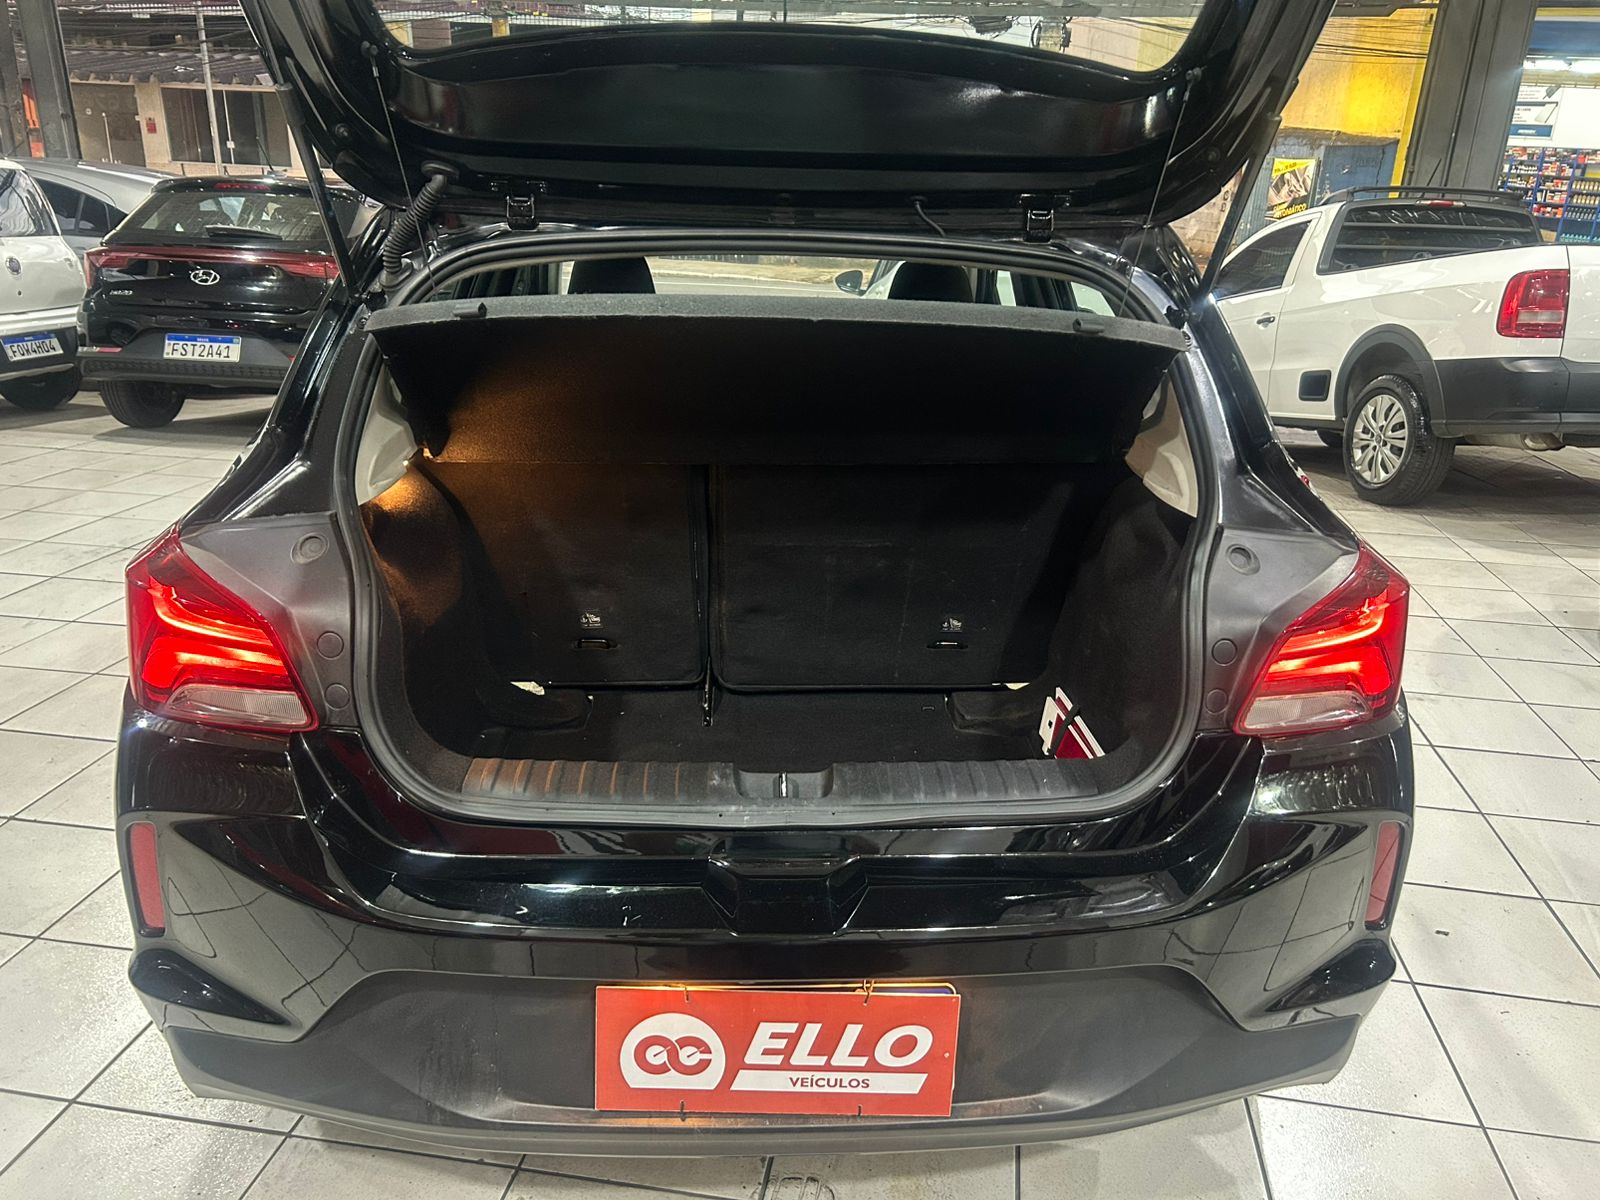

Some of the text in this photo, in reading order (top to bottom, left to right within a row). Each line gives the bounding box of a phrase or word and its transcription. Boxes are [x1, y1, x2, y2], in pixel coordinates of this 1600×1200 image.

[170, 342, 231, 359] FST2A41
[743, 1021, 934, 1068] ELLO
[788, 1074, 871, 1089] VEÍCULOS
